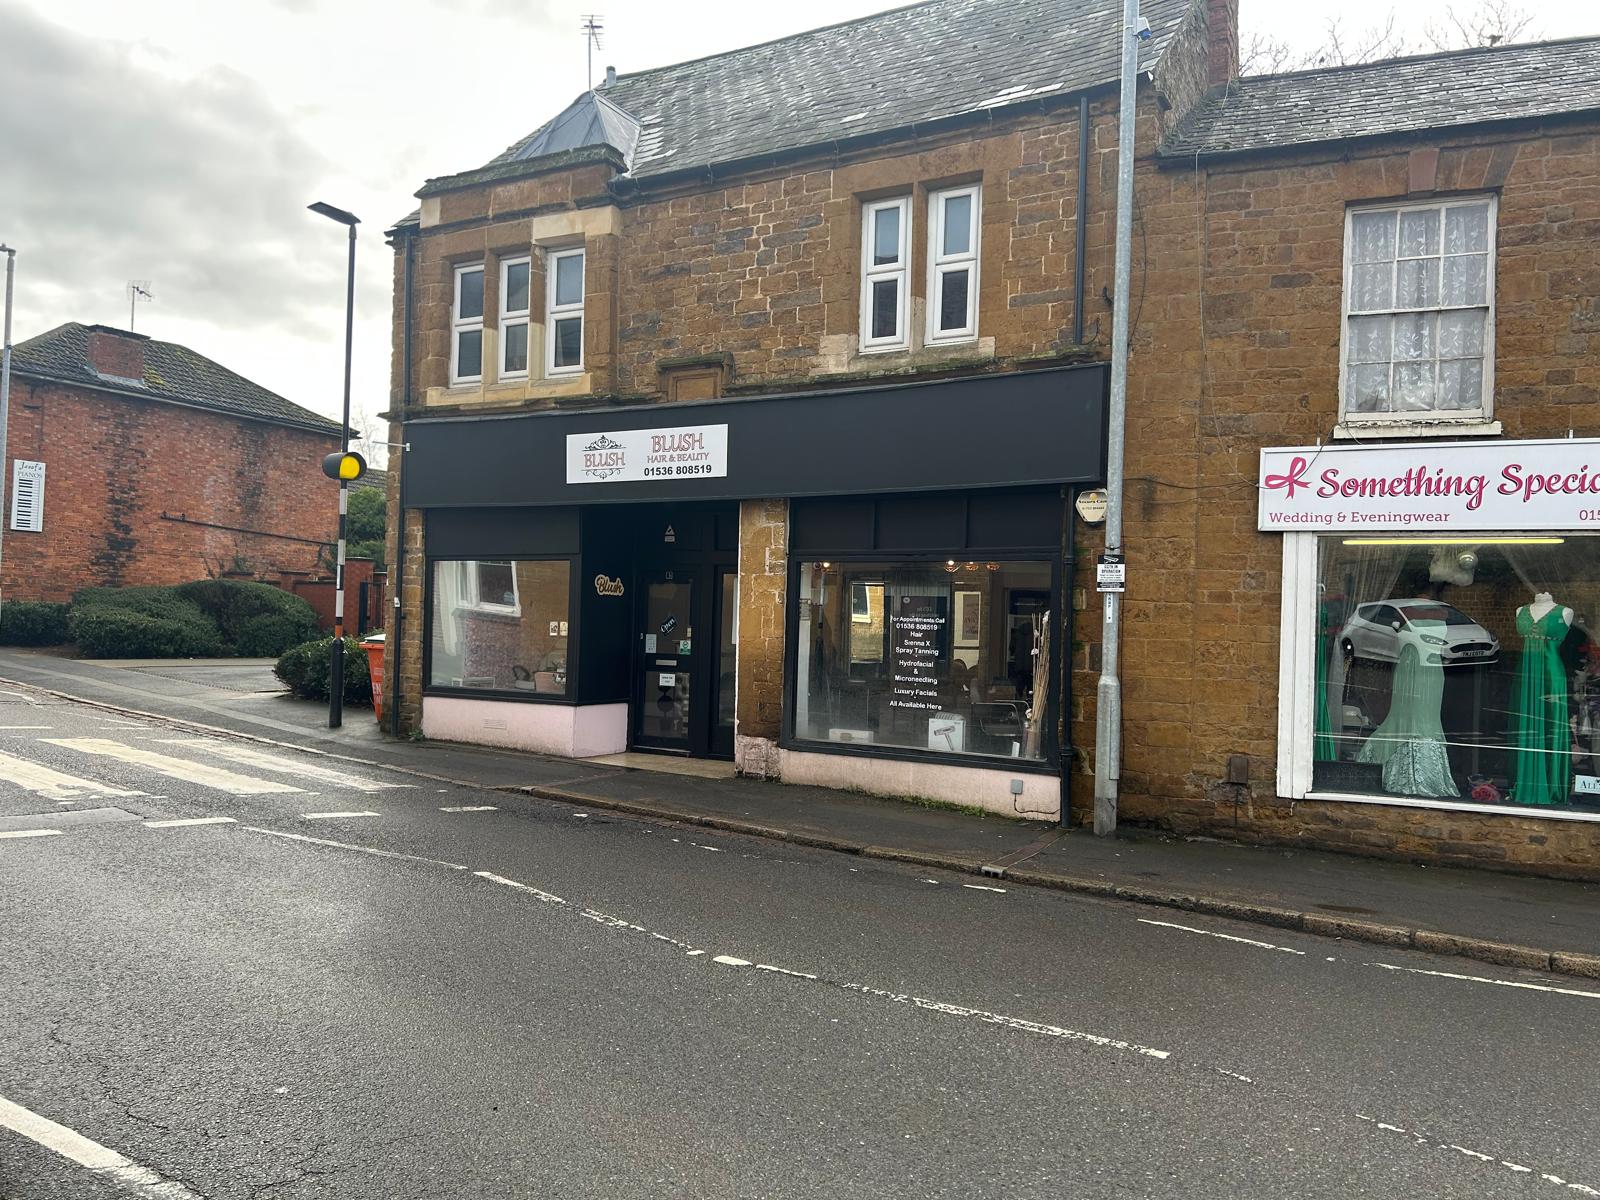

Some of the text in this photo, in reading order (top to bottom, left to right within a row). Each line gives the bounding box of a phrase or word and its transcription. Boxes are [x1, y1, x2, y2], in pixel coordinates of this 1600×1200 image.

[651, 433, 705, 453] BLUSH
[584, 452, 626, 468] BLUSH
[647, 455, 667, 463] HAIR
[677, 452, 709, 462] BEAUTY
[644, 464, 712, 477] 01536 808519
[1316, 465, 1490, 511] Something
[1269, 511, 1450, 525] Wedding & Eveningwear
[595, 575, 624, 595] Blush
[916, 623, 938, 631] 808519
[895, 646, 939, 656] Spray Tanning
[899, 660, 934, 668] Hydrofacial
[894, 675, 938, 685] Microneedling
[894, 687, 938, 697] Luxury Facials
[898, 701, 926, 709] Available
[926, 703, 942, 711] Here
